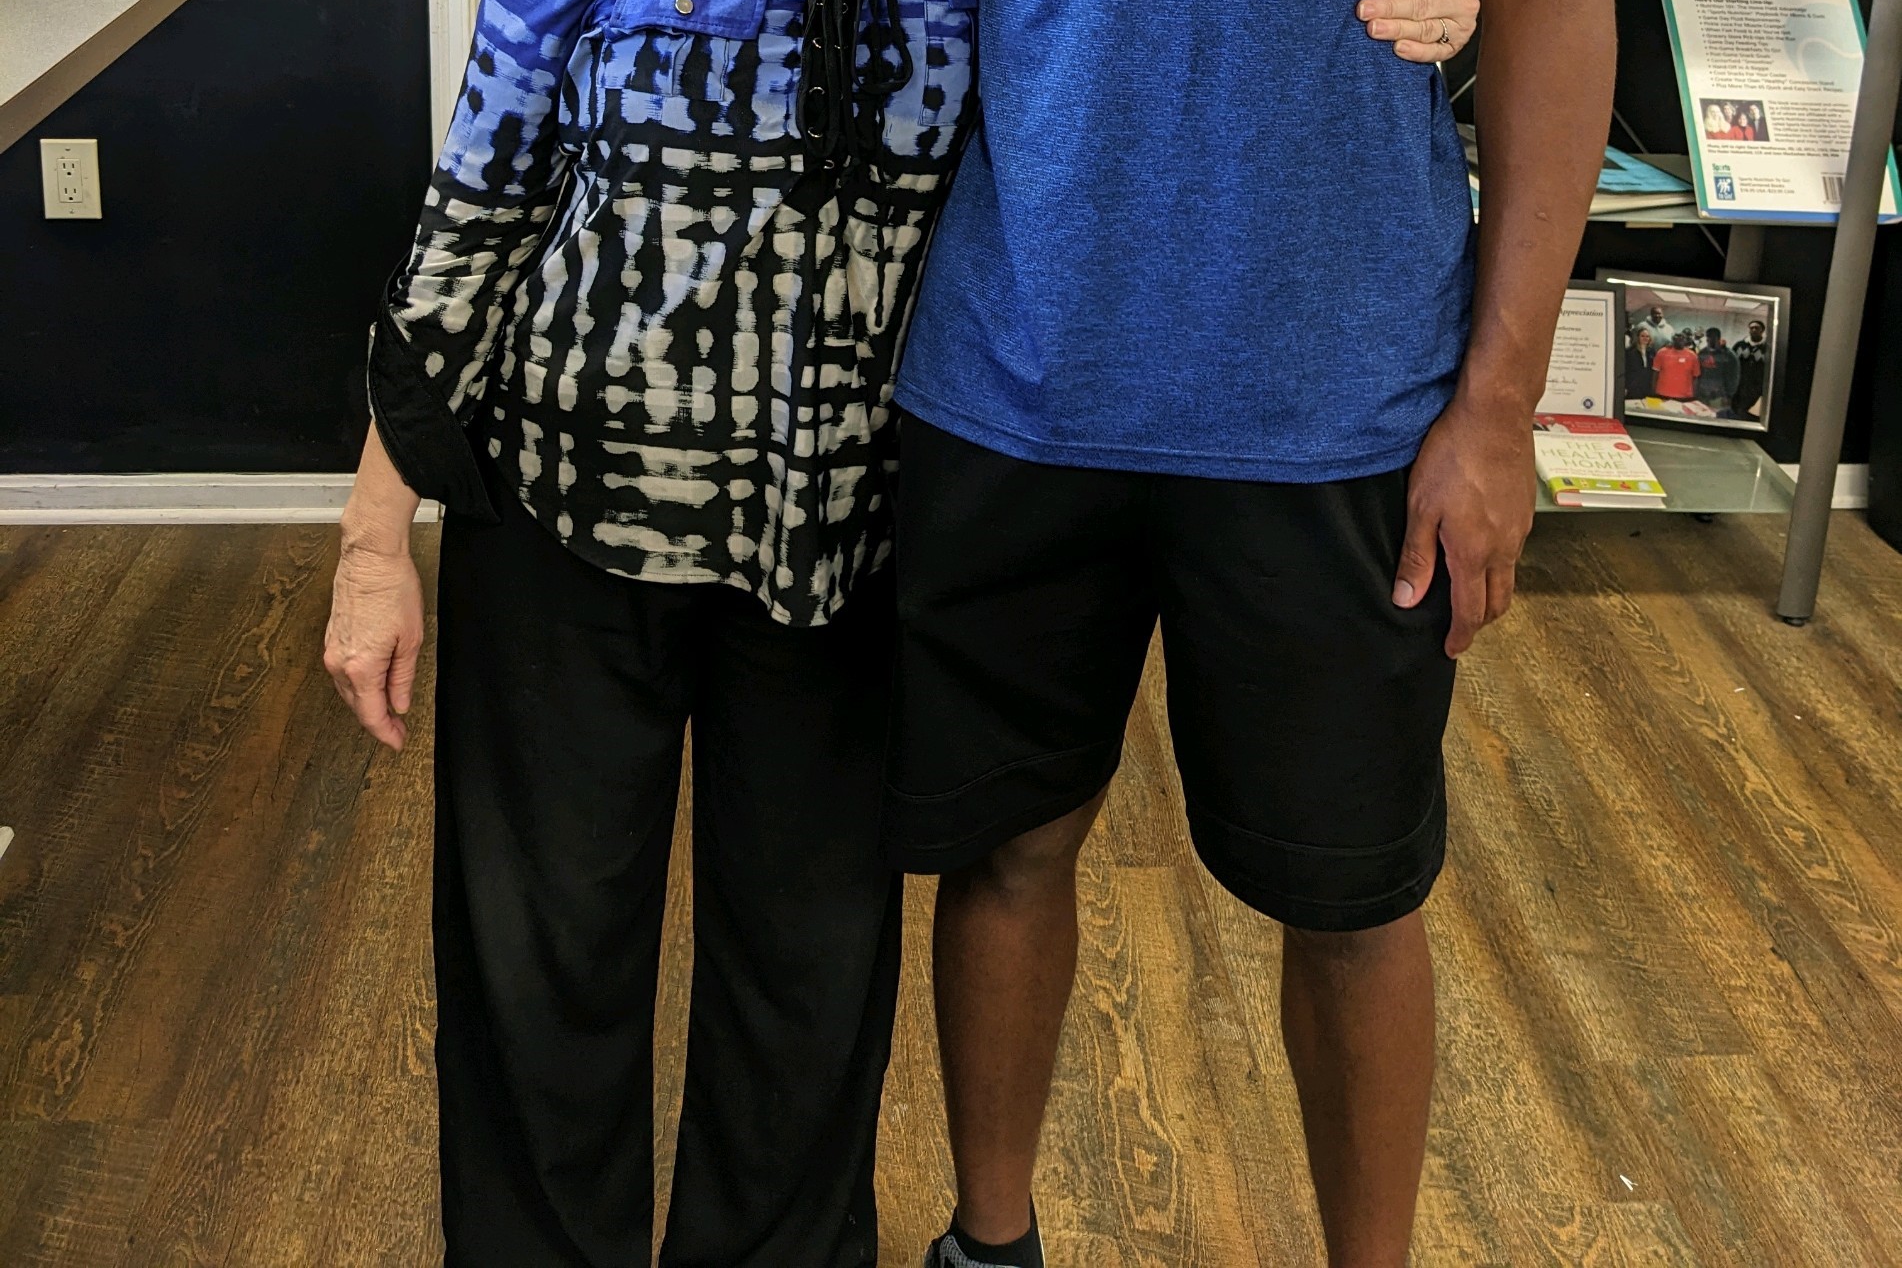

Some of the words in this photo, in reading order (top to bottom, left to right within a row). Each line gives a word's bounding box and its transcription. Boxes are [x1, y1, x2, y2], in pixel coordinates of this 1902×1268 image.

[1564, 441, 1604, 451] THE
[1541, 449, 1636, 460] HEALTHY
[1563, 459, 1626, 470] HOME
